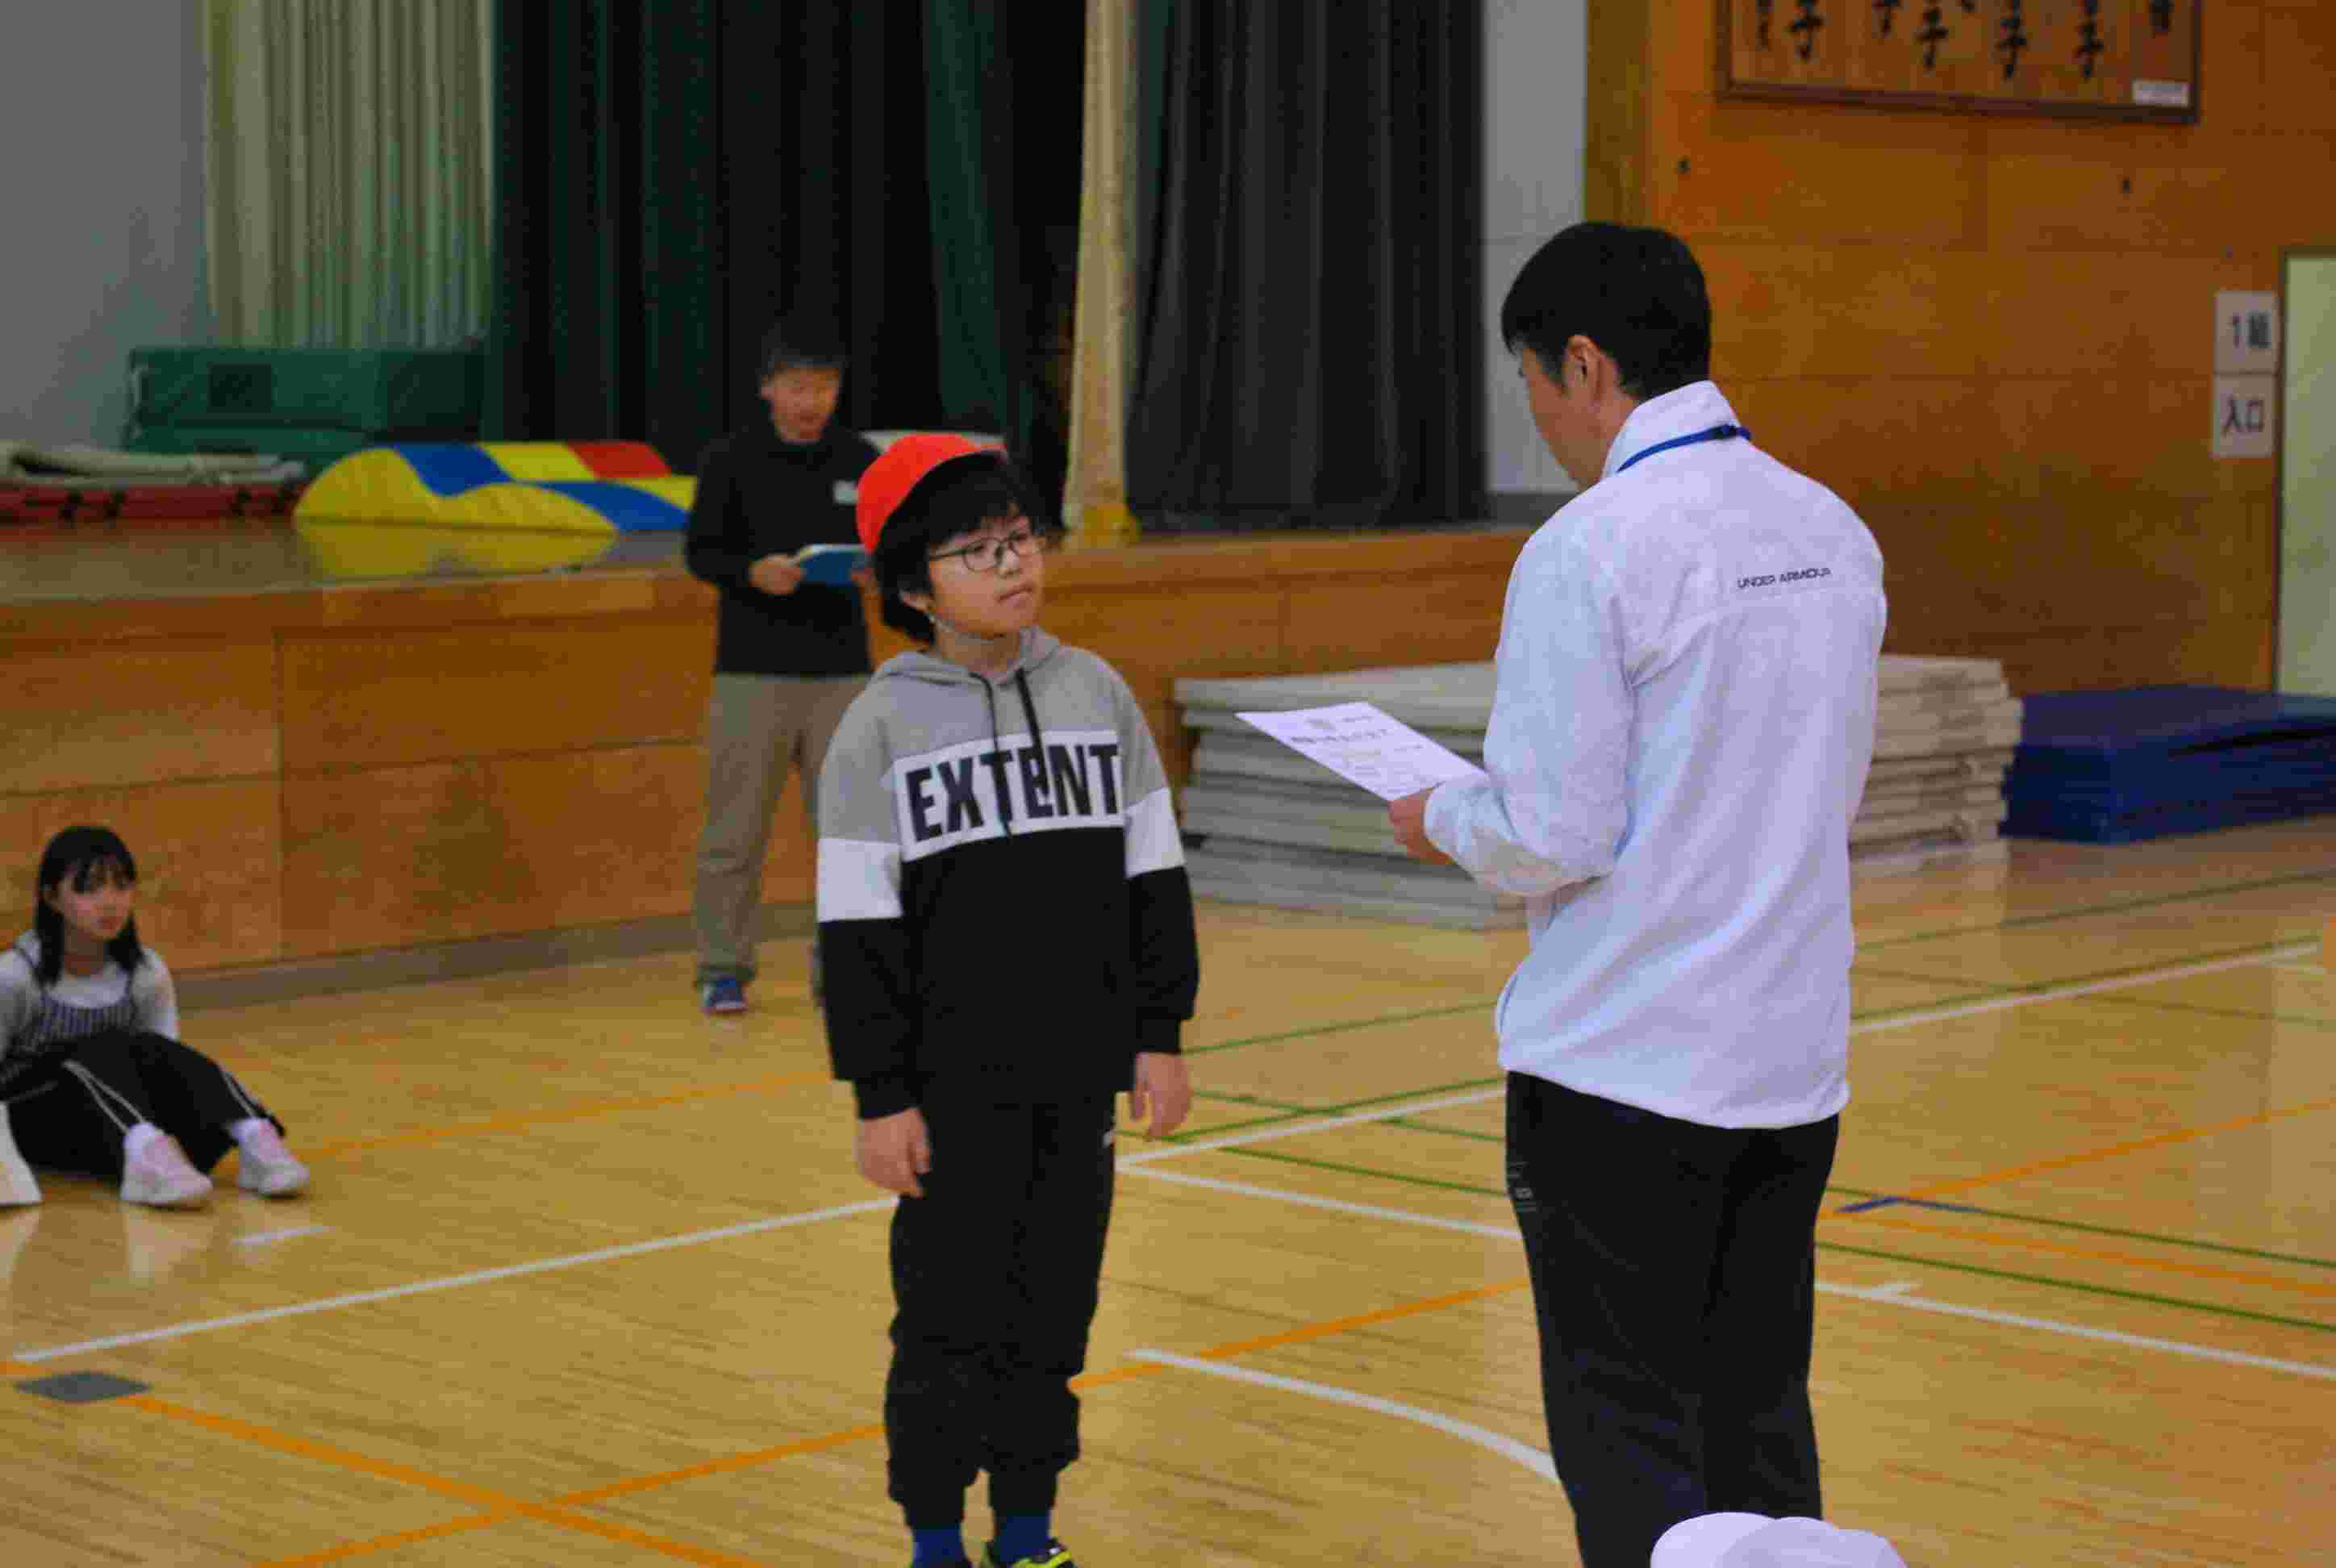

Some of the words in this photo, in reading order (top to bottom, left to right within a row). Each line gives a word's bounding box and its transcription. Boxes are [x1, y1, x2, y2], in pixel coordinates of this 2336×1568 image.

[2221, 397, 2265, 438] 入口
[1737, 573, 1776, 590] UNDER
[904, 744, 1120, 843] EXTENT
